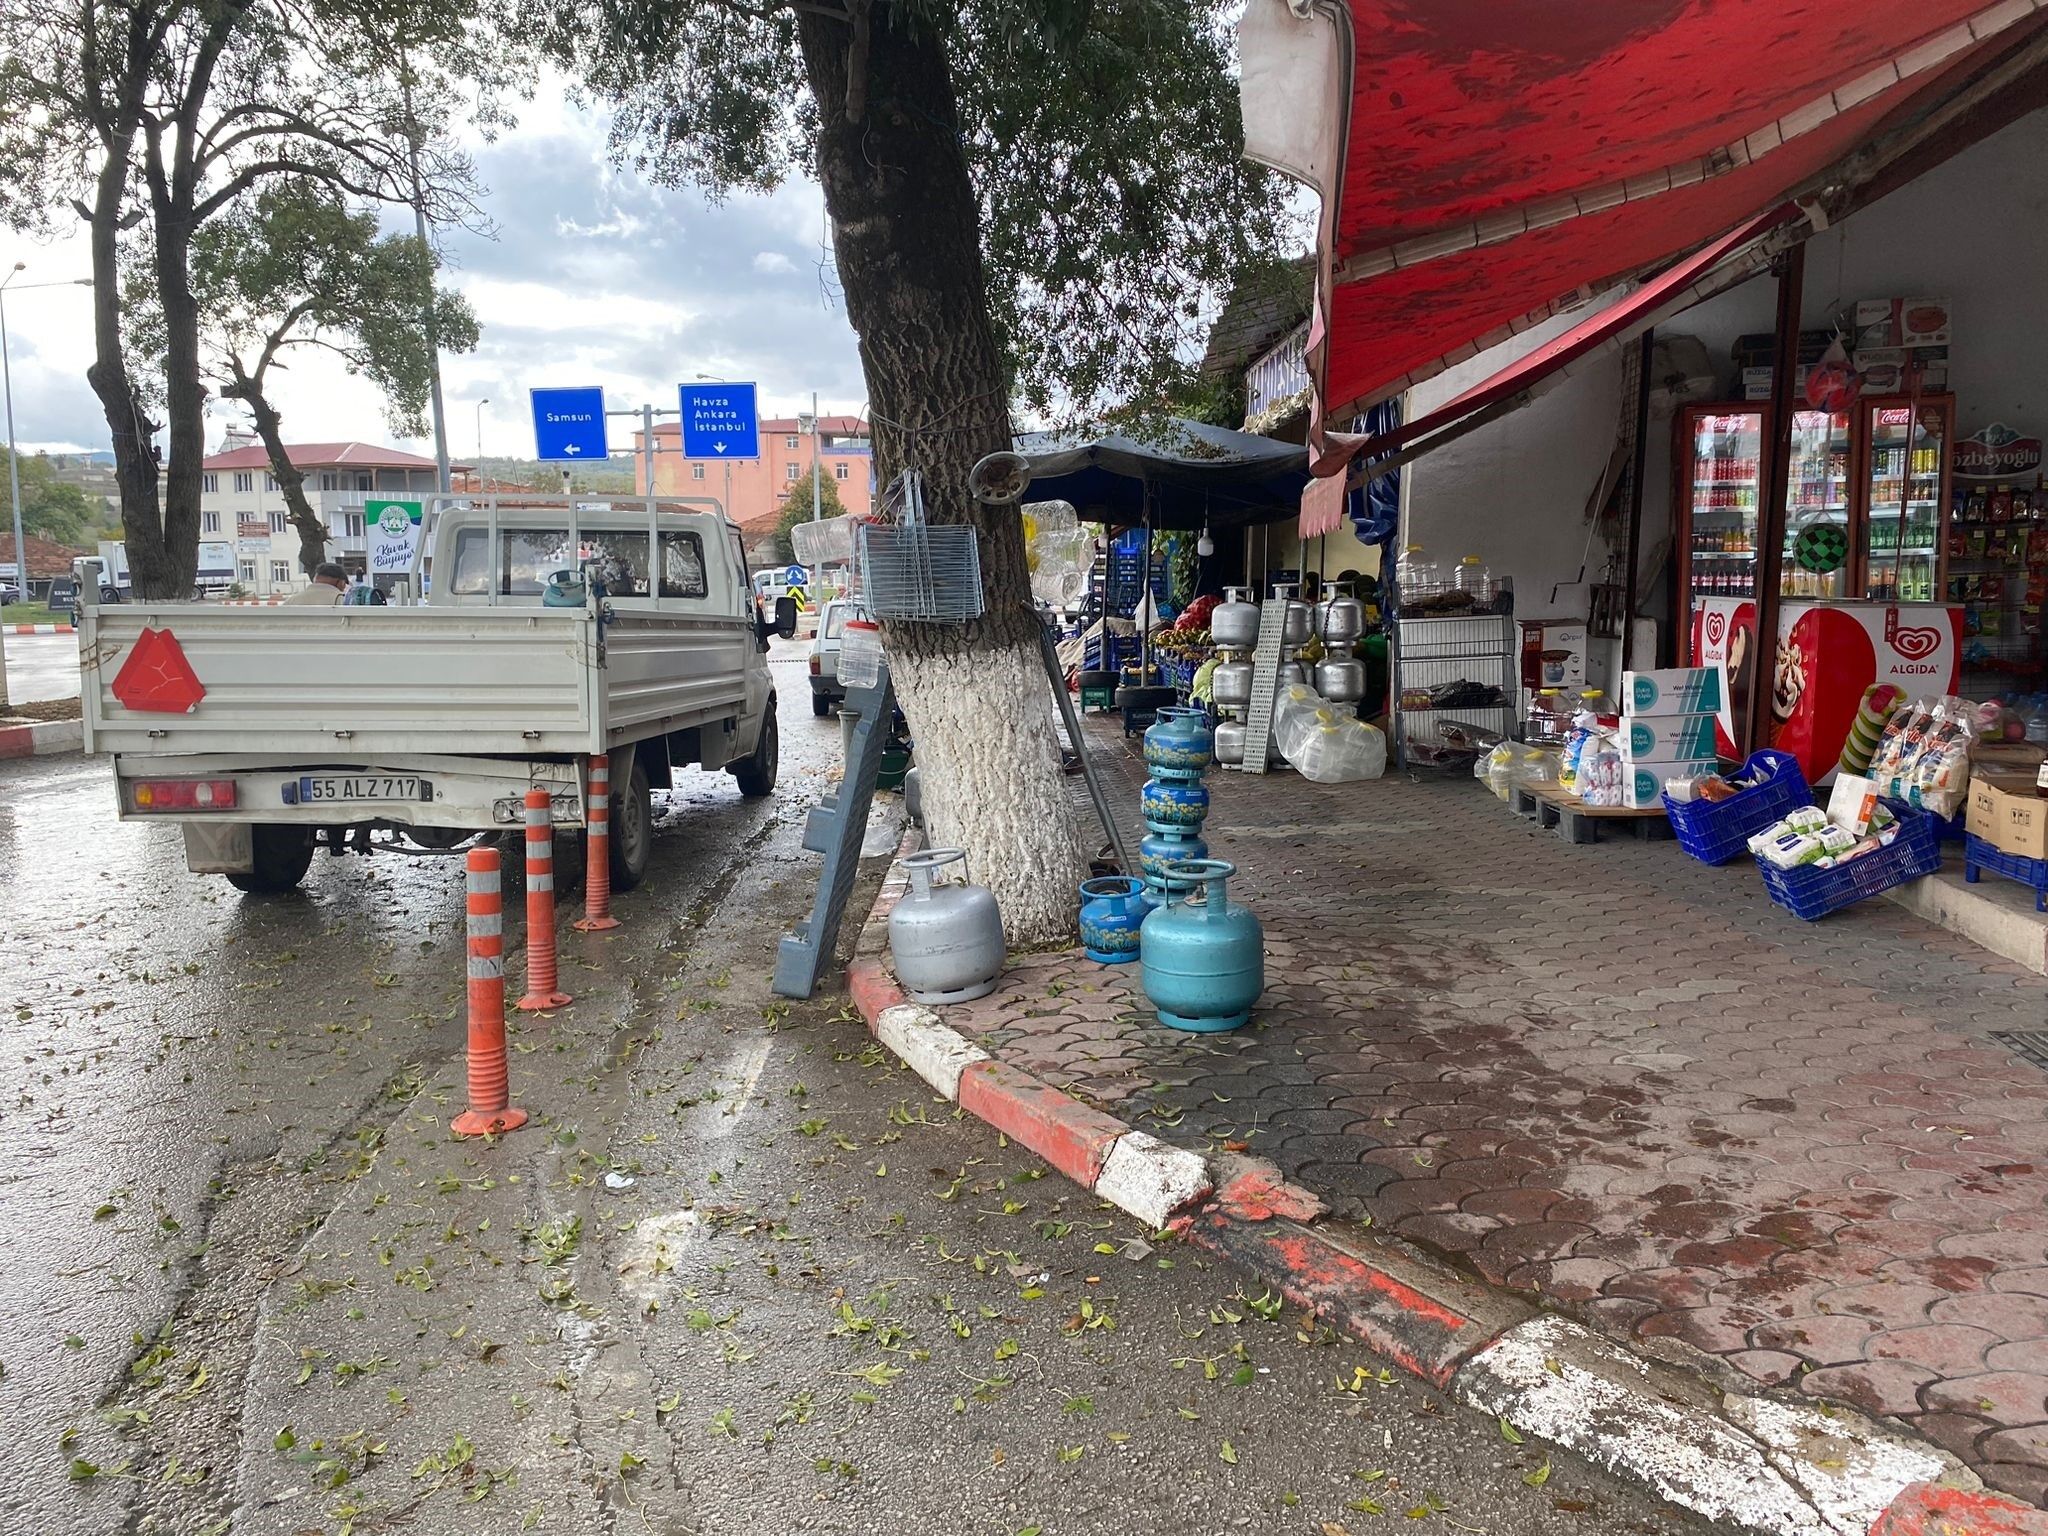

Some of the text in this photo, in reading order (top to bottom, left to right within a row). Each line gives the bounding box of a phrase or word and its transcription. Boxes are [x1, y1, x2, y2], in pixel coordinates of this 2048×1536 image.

[693, 397, 729, 407] Havza
[546, 413, 592, 422] Samsun
[695, 409, 737, 419] Ankara
[695, 420, 746, 432] İstanbul
[376, 540, 410, 557] Kavak
[312, 779, 416, 798] 55 ALZ 717
